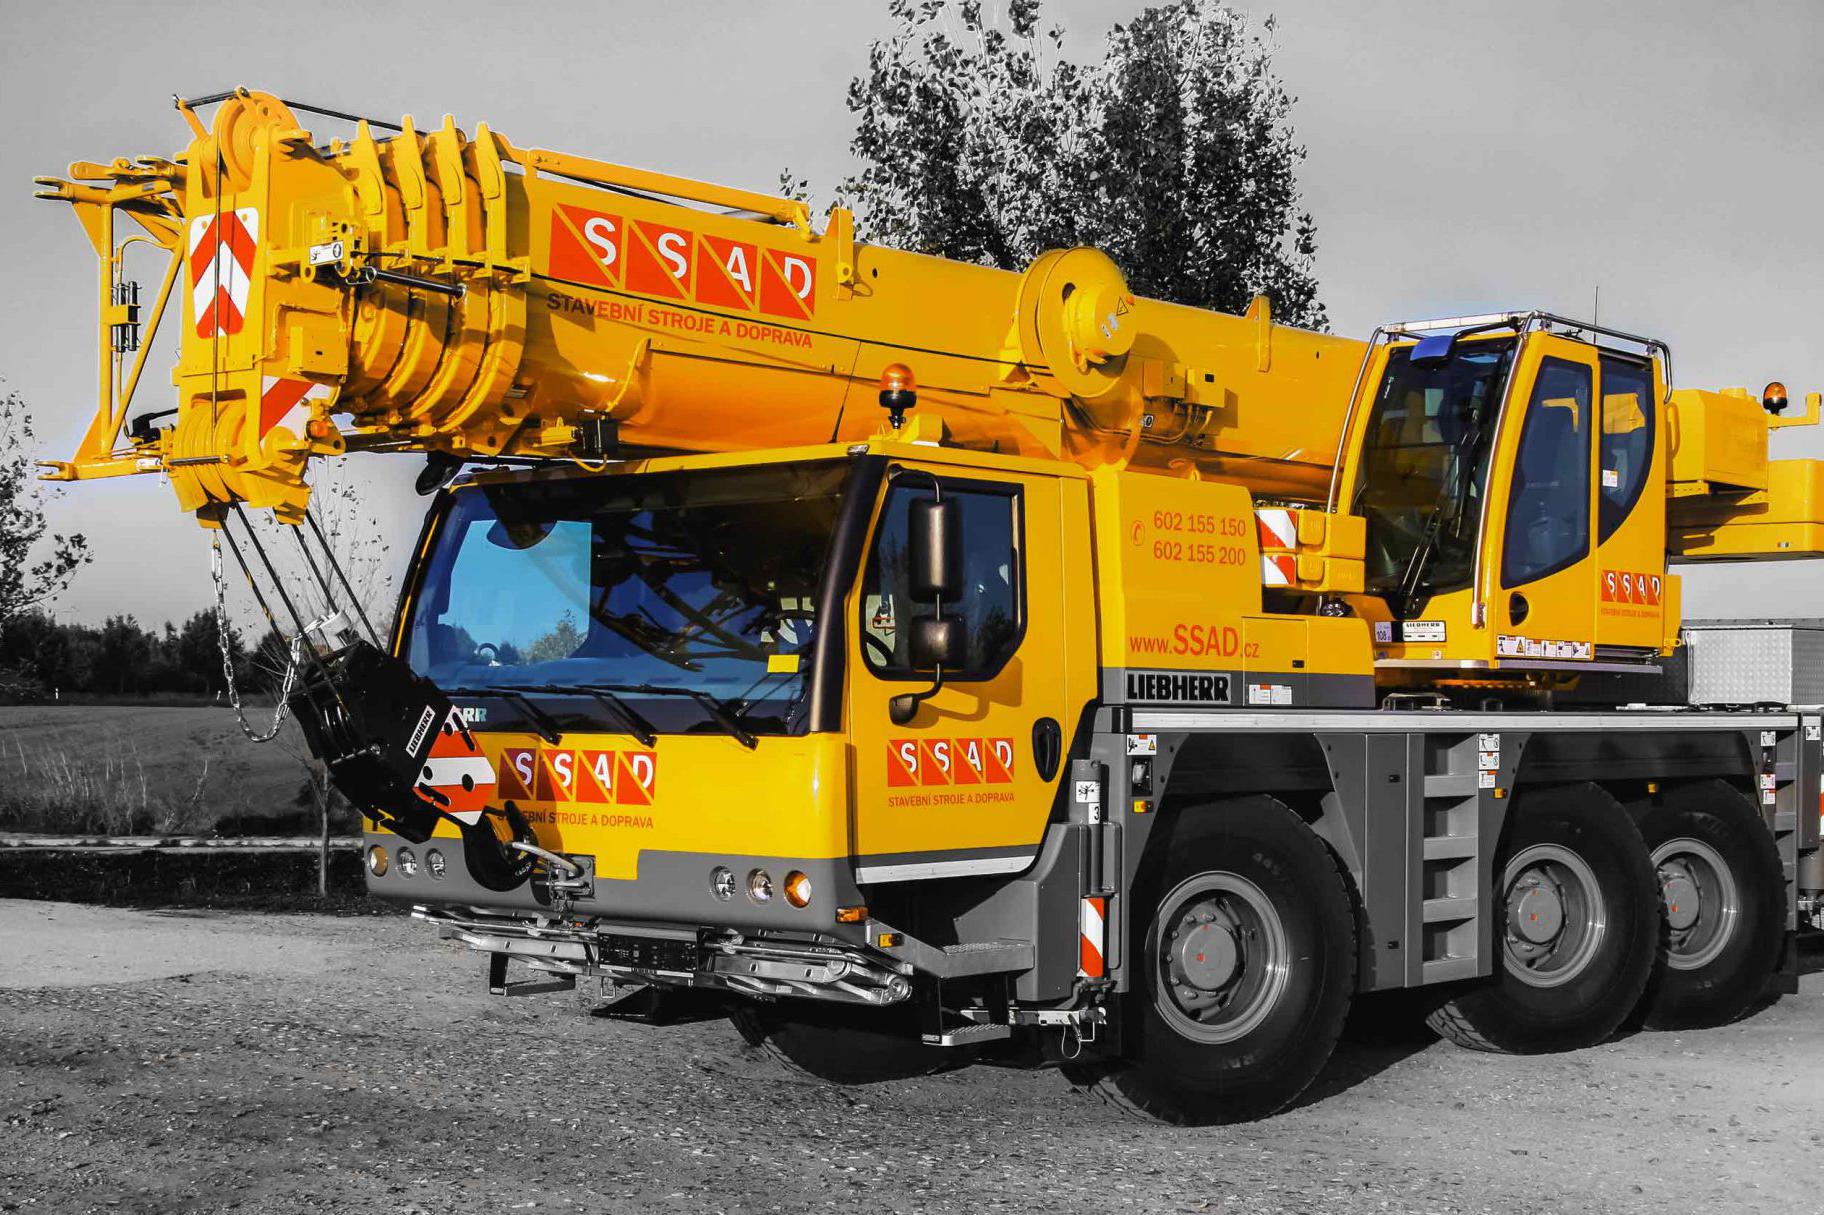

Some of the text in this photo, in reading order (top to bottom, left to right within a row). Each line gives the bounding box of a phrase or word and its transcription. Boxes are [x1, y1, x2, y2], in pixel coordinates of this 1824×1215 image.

[584, 217, 812, 299] SSAD
[547, 293, 812, 348] STAVEBNÍ STROJE A DOPRAVA
[1154, 511, 1246, 537] 602 155 150
[1154, 541, 1246, 566] 602 155 200
[1607, 573, 1660, 596] SSAD
[1130, 624, 1260, 658] www.SSAD.cz
[1127, 673, 1230, 701] LIEBHERR
[408, 710, 433, 754] LIEBHERR
[515, 752, 654, 789] SSAD
[900, 741, 1012, 773] SSAD
[888, 792, 1015, 807] STAVEBNÍ STROJE A DOPRAVA
[549, 811, 588, 826] STROJE
[591, 814, 598, 826] A
[601, 815, 654, 828] DOPRAVA
